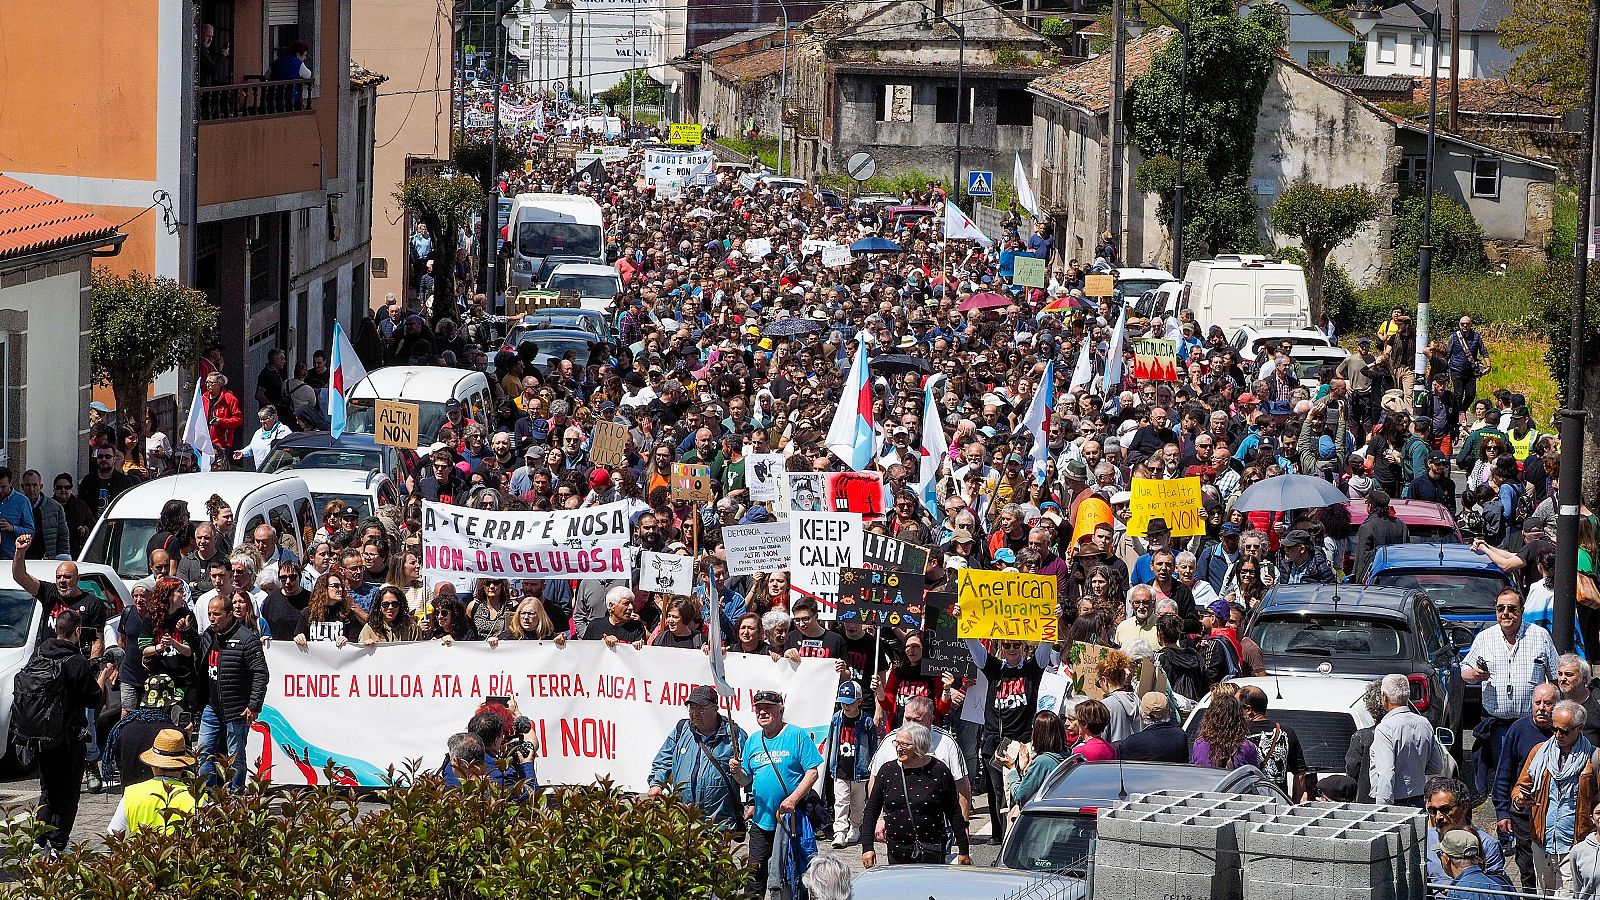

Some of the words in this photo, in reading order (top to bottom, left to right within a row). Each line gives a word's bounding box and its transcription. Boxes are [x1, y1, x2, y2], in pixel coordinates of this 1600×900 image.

[648, 154, 652, 162] A
[656, 155, 676, 164] AUGA
[686, 156, 708, 164] NOSA
[666, 168, 670, 176] E
[676, 168, 691, 176] NON
[380, 408, 412, 426] ALTRI
[383, 425, 411, 444] NON
[599, 422, 624, 438] RIO
[690, 467, 710, 477] ULLA
[678, 479, 702, 490] VIVO
[1158, 483, 1194, 498] Health
[1180, 498, 1196, 506] SALE
[424, 508, 436, 532] A
[451, 513, 524, 540] TERRA
[542, 514, 554, 539] É
[567, 510, 624, 537] NOSA
[1171, 508, 1200, 530] NON
[800, 518, 850, 542] KEEP
[800, 546, 850, 568] CALM
[864, 534, 905, 564] LTRI
[476, 550, 504, 572] DA
[510, 548, 624, 574] CELULOSA
[871, 572, 900, 587] RIO
[960, 572, 1054, 600] American
[860, 588, 904, 605] ULLA
[860, 609, 900, 625] VIVO
[980, 598, 1052, 618] Pilgrams
[960, 610, 980, 634] SAY
[990, 618, 1038, 637] ALTRI
[1040, 618, 1056, 642] NON
[926, 628, 944, 646] Por
[284, 674, 340, 698] DENDE
[348, 674, 360, 698] A
[368, 674, 424, 698] ULLOA
[432, 674, 462, 698] ATA
[470, 674, 482, 698] A
[490, 670, 519, 698] RÍA.
[527, 674, 590, 699] TERRA,
[597, 674, 637, 700] AUGA
[644, 680, 652, 703] E
[994, 694, 1028, 709] NON
[561, 718, 616, 760] NON!
